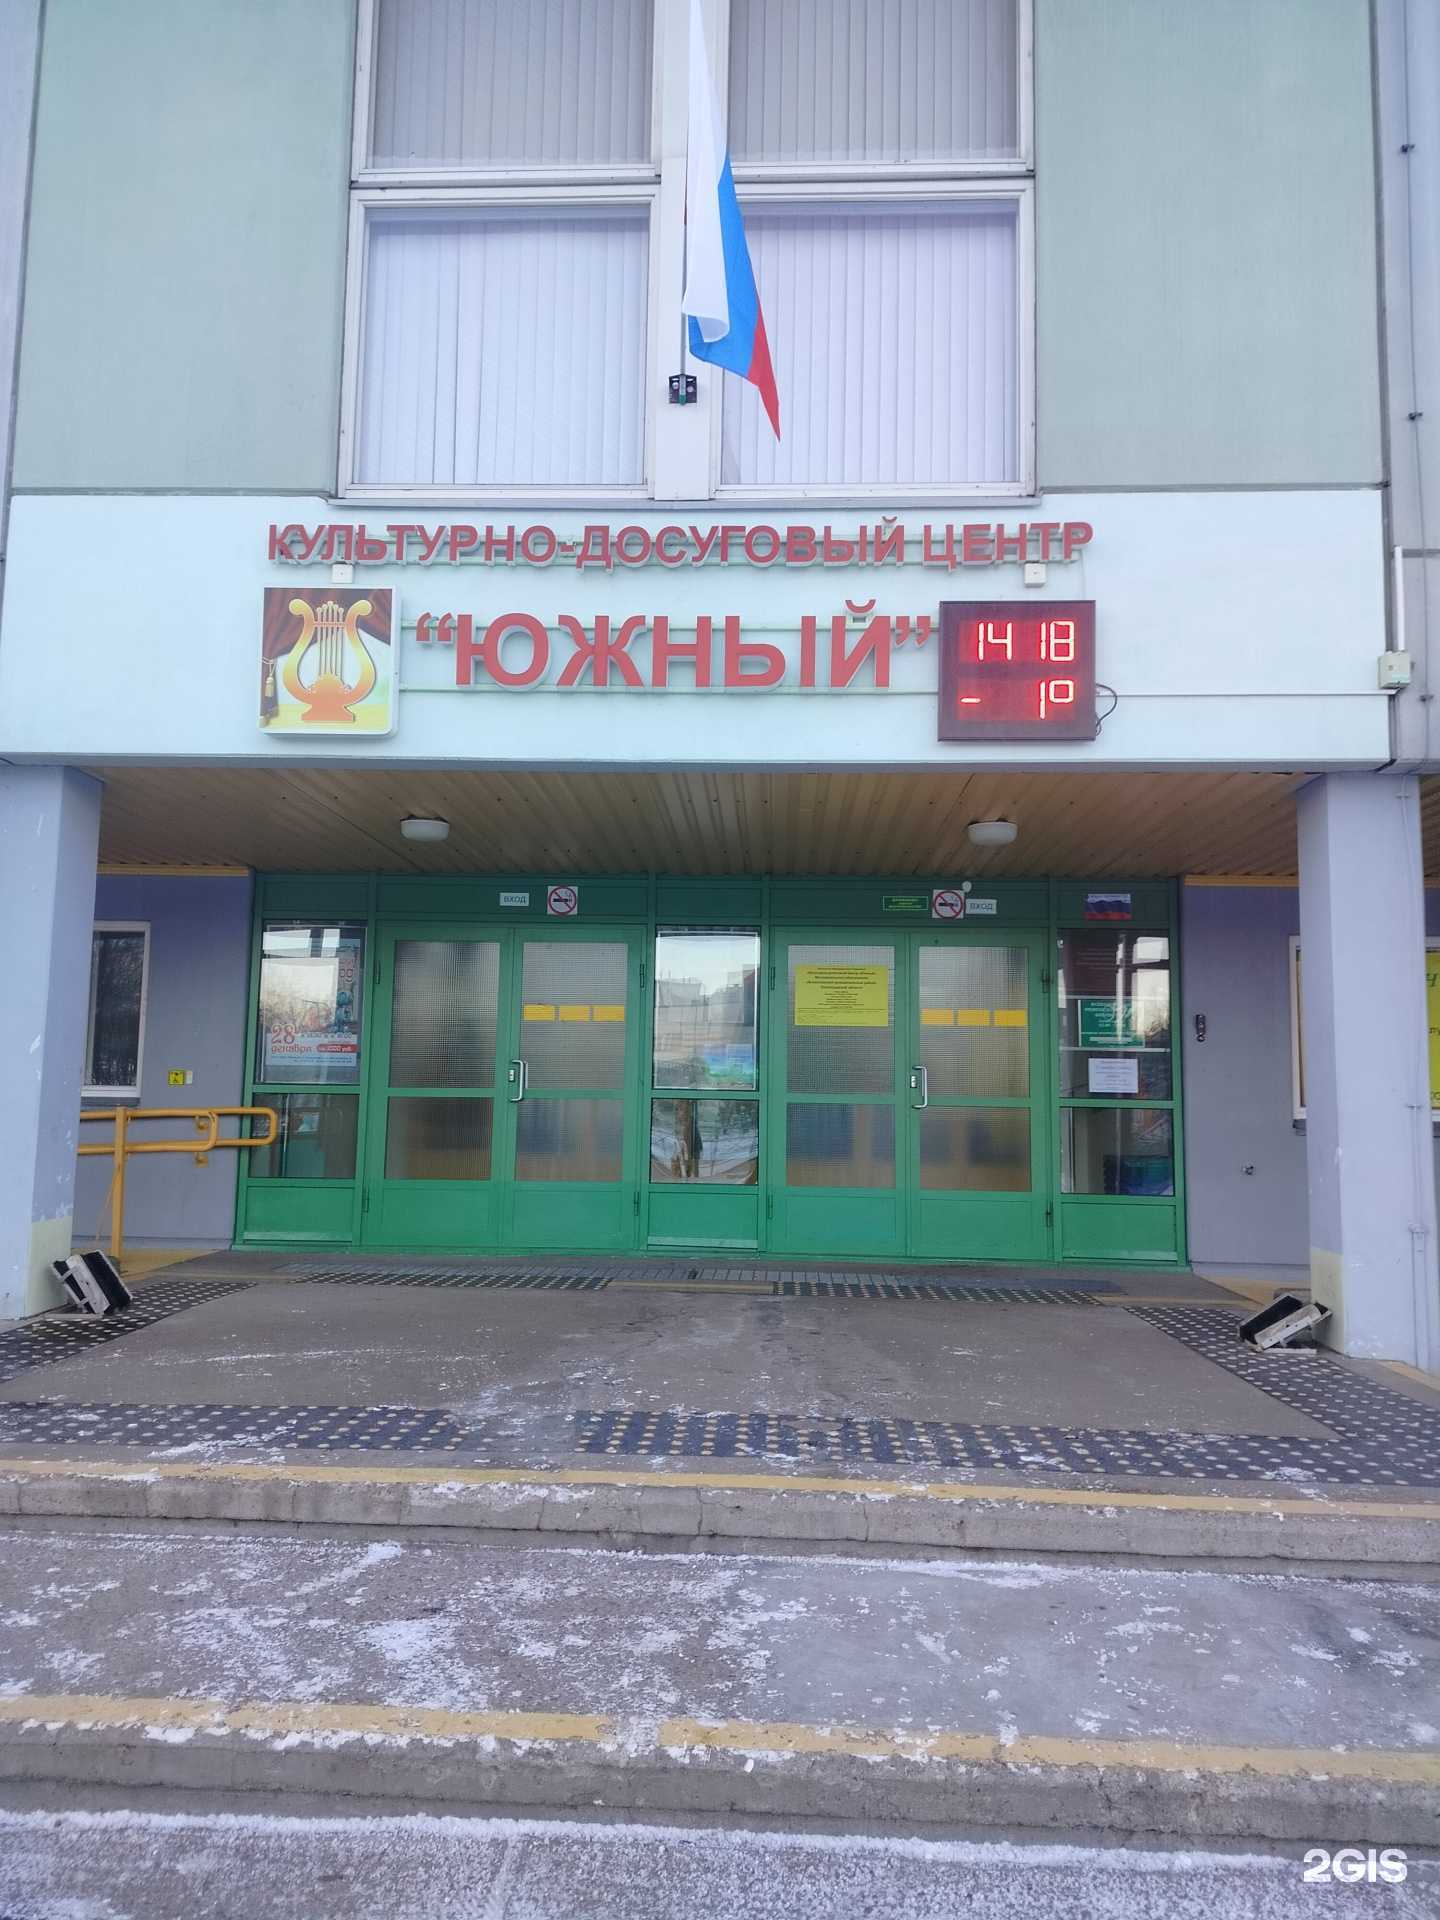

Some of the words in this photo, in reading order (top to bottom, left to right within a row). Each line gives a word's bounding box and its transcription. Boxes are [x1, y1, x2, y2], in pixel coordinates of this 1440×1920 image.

[268, 516, 905, 570] КУЛЬТУРНО-ДОСУГОВЫЙ
[923, 521, 1093, 570] ЦЕНТР
[977, 621, 1013, 661] 14
[1040, 620, 1075, 662] 18
[503, 894, 527, 905] ВХОД
[271, 1024, 296, 1044] 28
